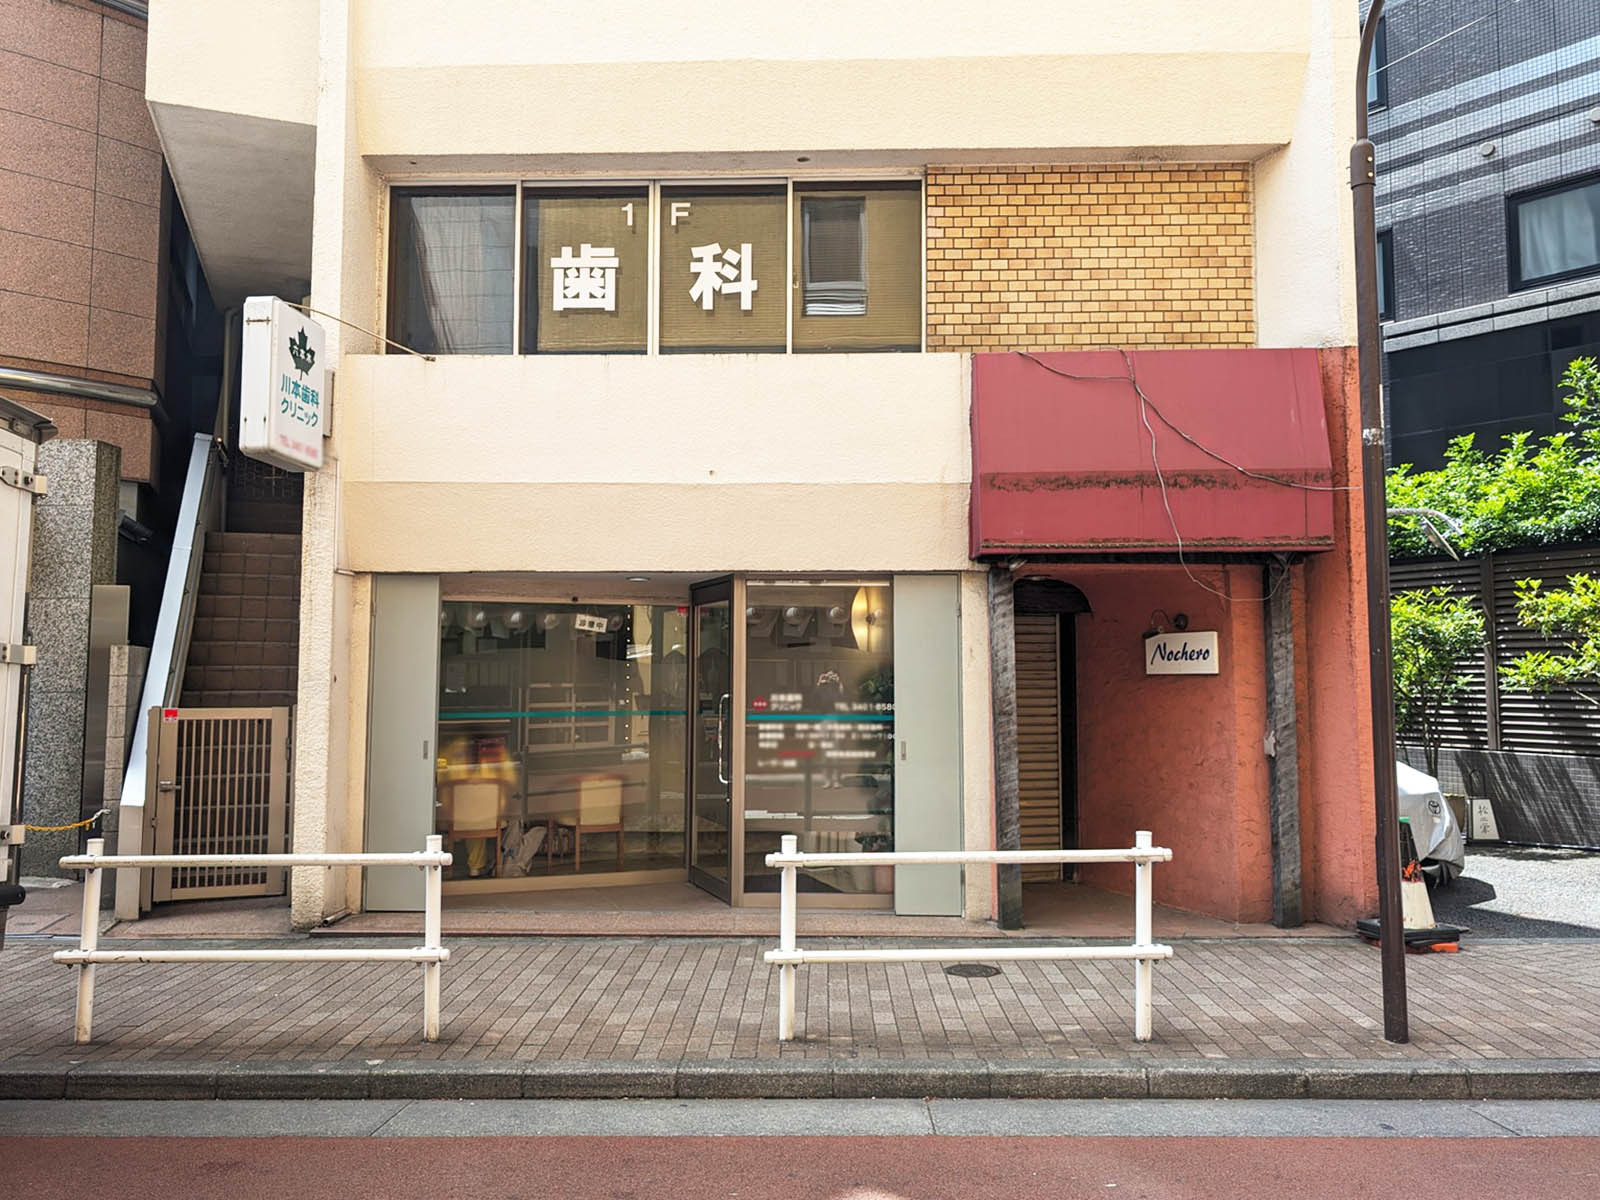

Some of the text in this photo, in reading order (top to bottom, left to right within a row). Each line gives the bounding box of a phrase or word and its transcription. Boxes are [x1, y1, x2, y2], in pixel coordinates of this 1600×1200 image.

[281, 373, 319, 409] 川本歯科
[281, 397, 318, 427] クリニック
[1151, 642, 1210, 665] Nochero
